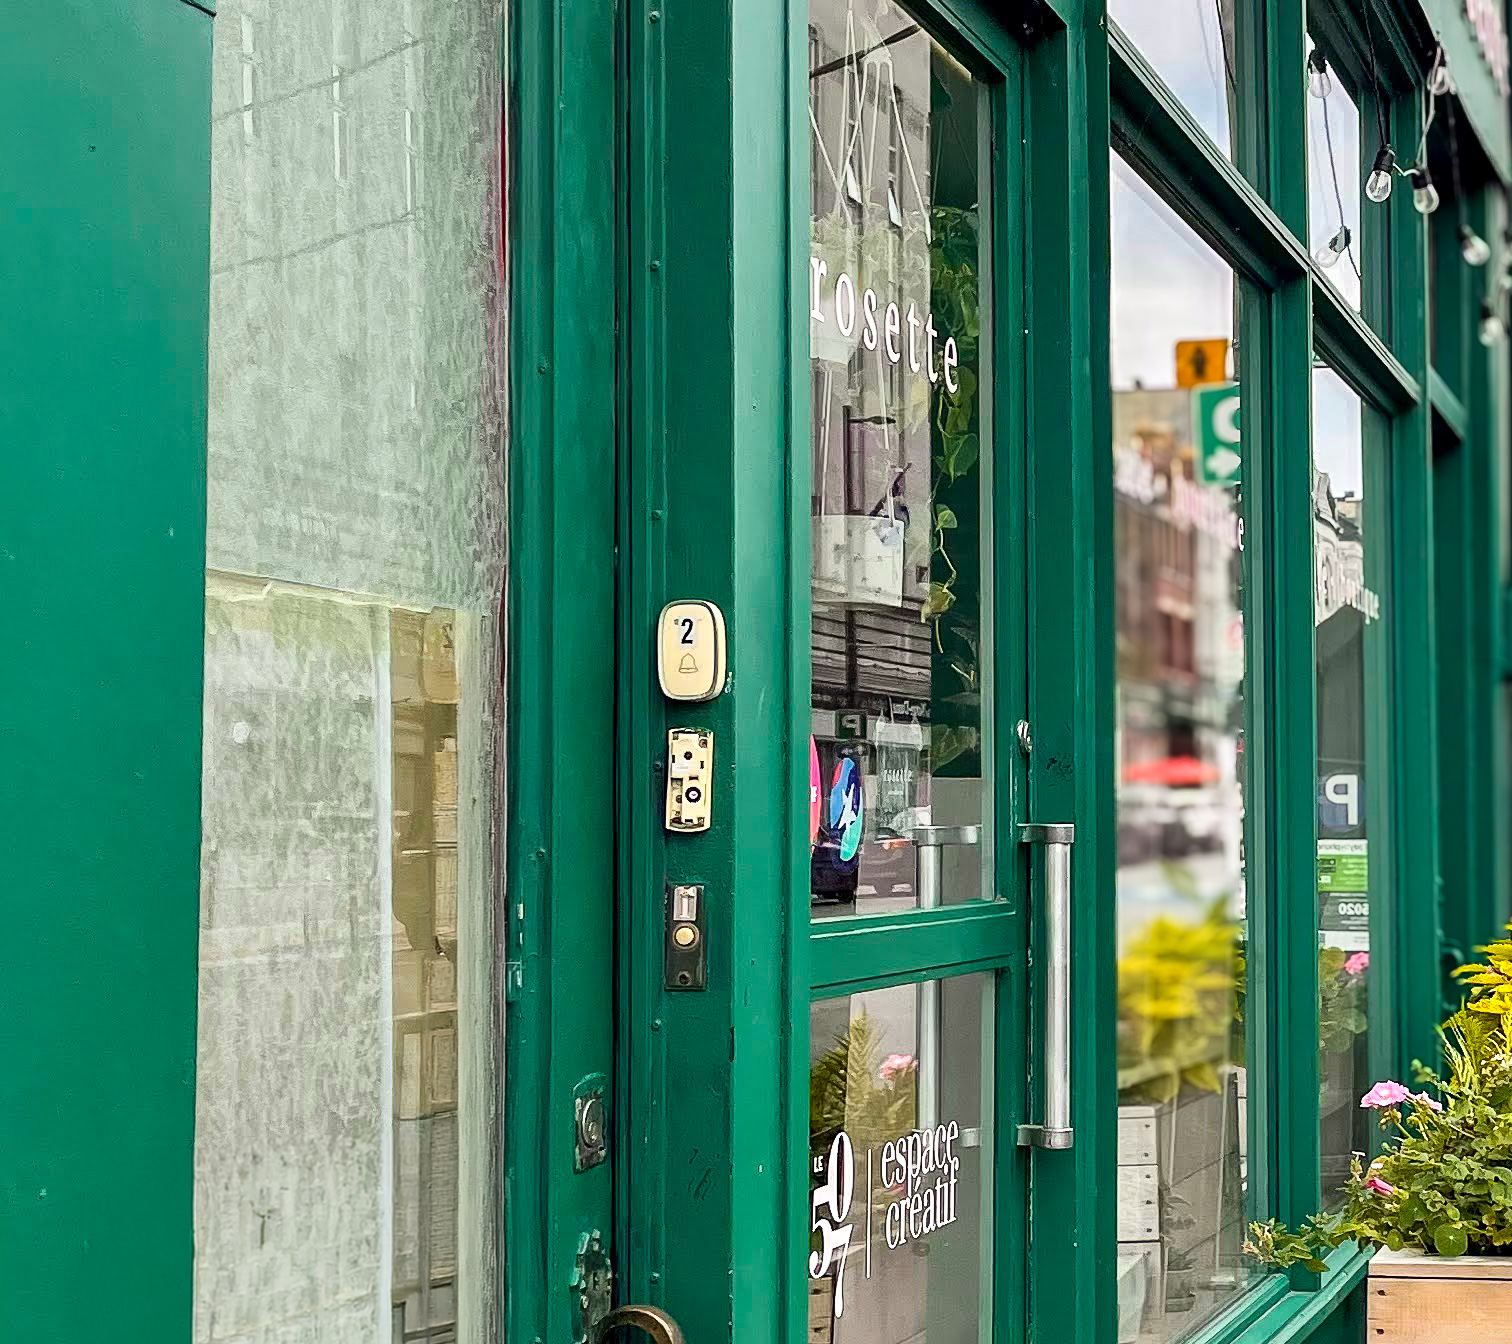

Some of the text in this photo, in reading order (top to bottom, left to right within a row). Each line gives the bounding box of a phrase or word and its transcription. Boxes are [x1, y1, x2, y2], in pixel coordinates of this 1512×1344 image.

[810, 256, 958, 394] rosette
[680, 618, 694, 645] 2
[814, 1155, 824, 1173] LE
[881, 1120, 959, 1197] espace
[885, 1157, 960, 1250] créatif
